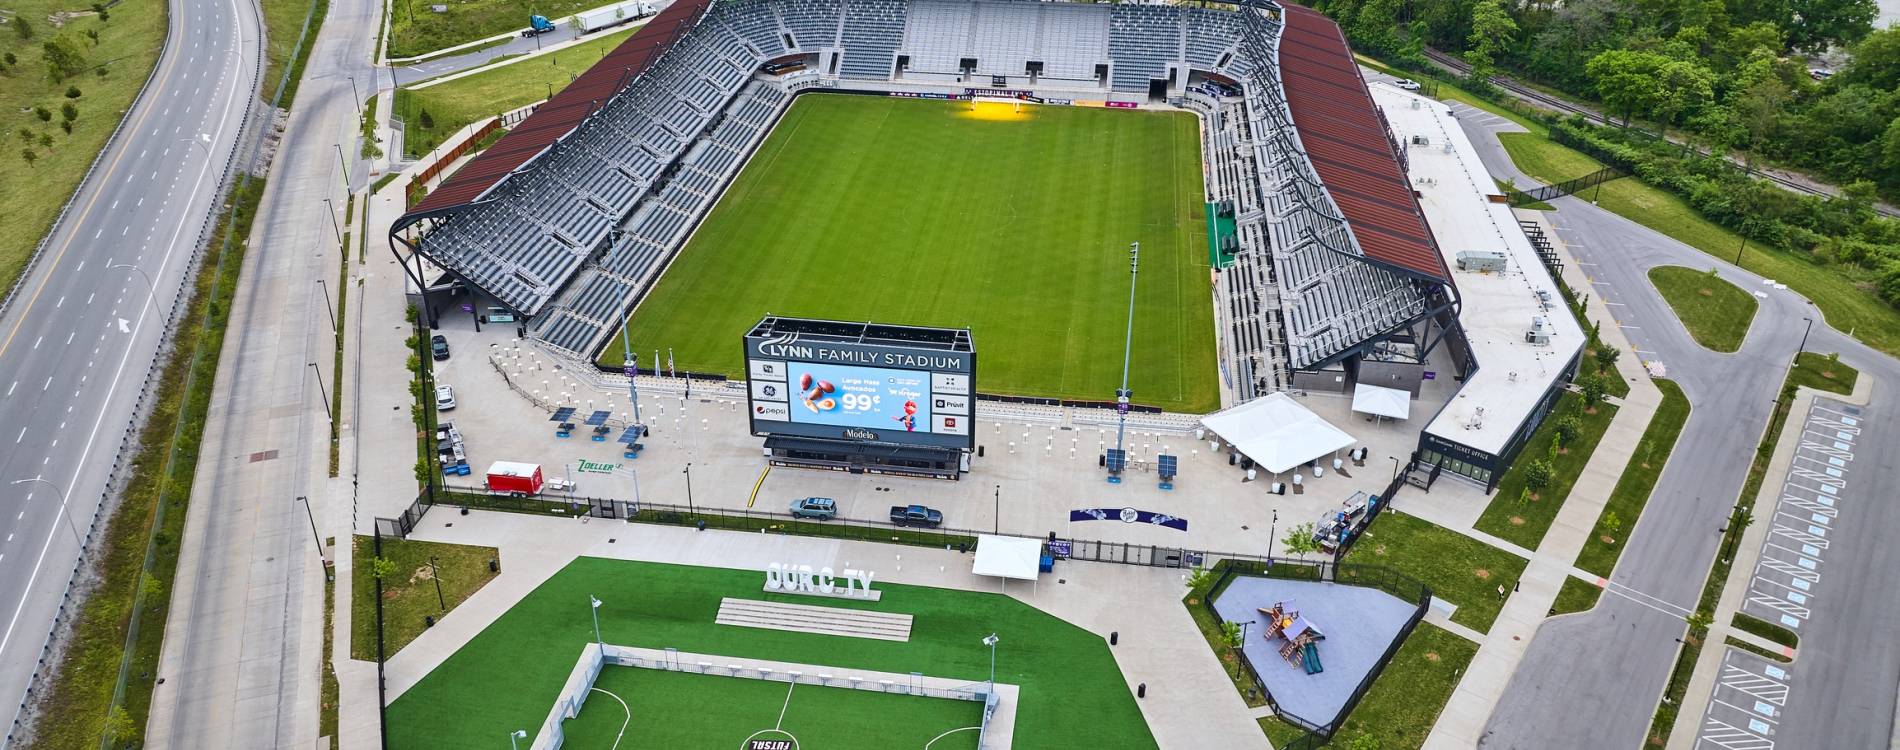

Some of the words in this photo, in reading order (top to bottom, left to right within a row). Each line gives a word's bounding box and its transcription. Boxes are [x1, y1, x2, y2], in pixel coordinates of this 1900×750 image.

[770, 344, 813, 359] LYNN
[819, 349, 879, 364] FAMILY
[885, 353, 960, 369] STADIUM
[765, 408, 786, 416] pepsi
[846, 428, 874, 440] Modelo
[1454, 444, 1471, 455] TICKET
[1471, 448, 1489, 460] OFFICE
[578, 459, 614, 473] ZOELLER
[767, 562, 815, 593] OUR
[752, 741, 790, 750] FUTSAL
